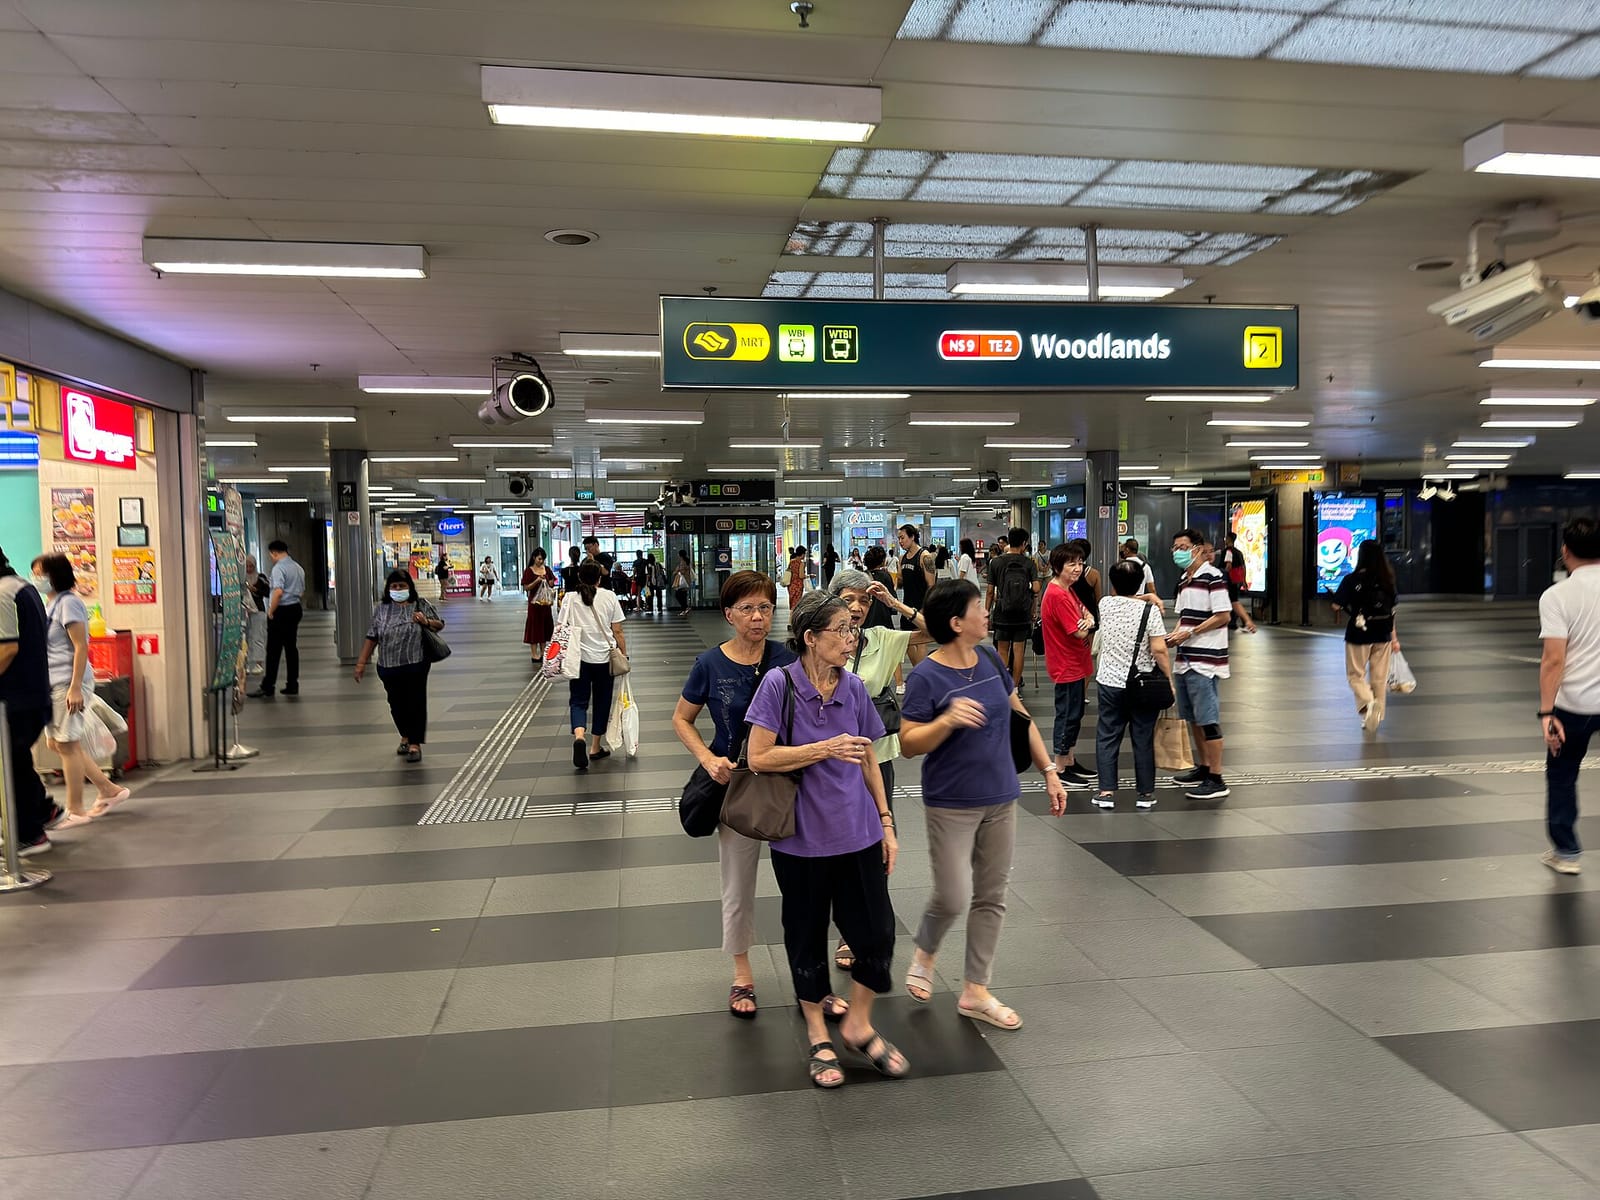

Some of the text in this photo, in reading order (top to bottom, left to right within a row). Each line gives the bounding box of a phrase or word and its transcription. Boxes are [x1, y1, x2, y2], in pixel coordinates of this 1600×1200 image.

[788, 328, 806, 338] WBI
[829, 329, 852, 340] WTBI
[741, 337, 765, 348] MRT
[1031, 332, 1171, 359] Woodlands
[1259, 343, 1269, 360] 2
[438, 521, 465, 532] Cheers
